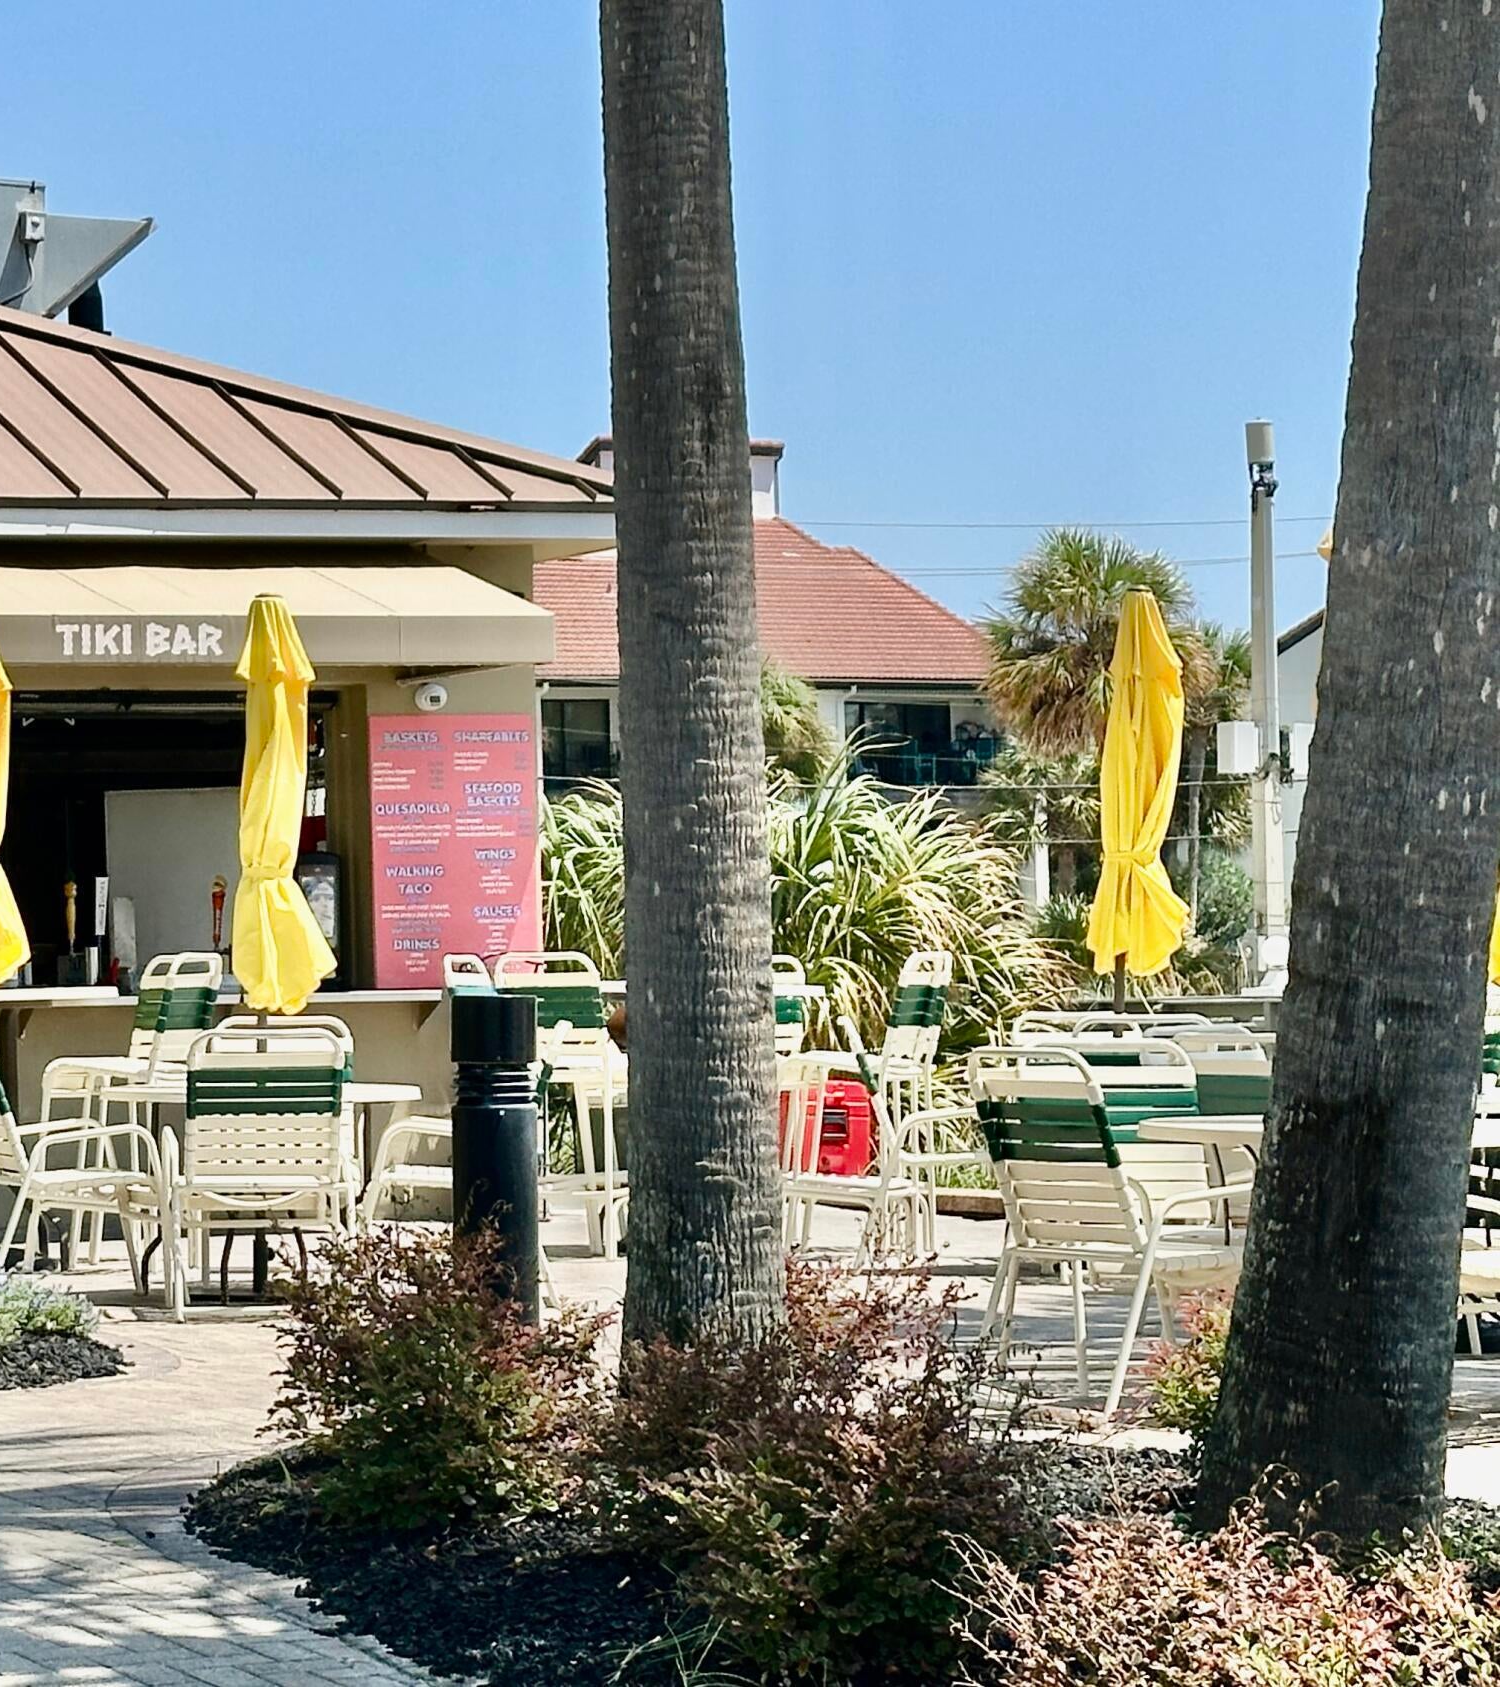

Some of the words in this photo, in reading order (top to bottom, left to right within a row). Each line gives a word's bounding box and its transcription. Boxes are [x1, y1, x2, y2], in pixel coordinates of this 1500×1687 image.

[55, 622, 132, 656] TIKI
[145, 621, 223, 657] BAR
[383, 730, 439, 743] BASKETS
[453, 730, 530, 743] SHAREABLES
[463, 782, 523, 794] SEAFOOD
[467, 795, 521, 807] BASKETS
[375, 803, 451, 815] QUESADILLA
[474, 848, 517, 860] WINGS
[385, 865, 445, 877] WALKING
[398, 883, 433, 895] TACO
[473, 905, 521, 917] SAUCES
[393, 938, 440, 951] DRINKS
